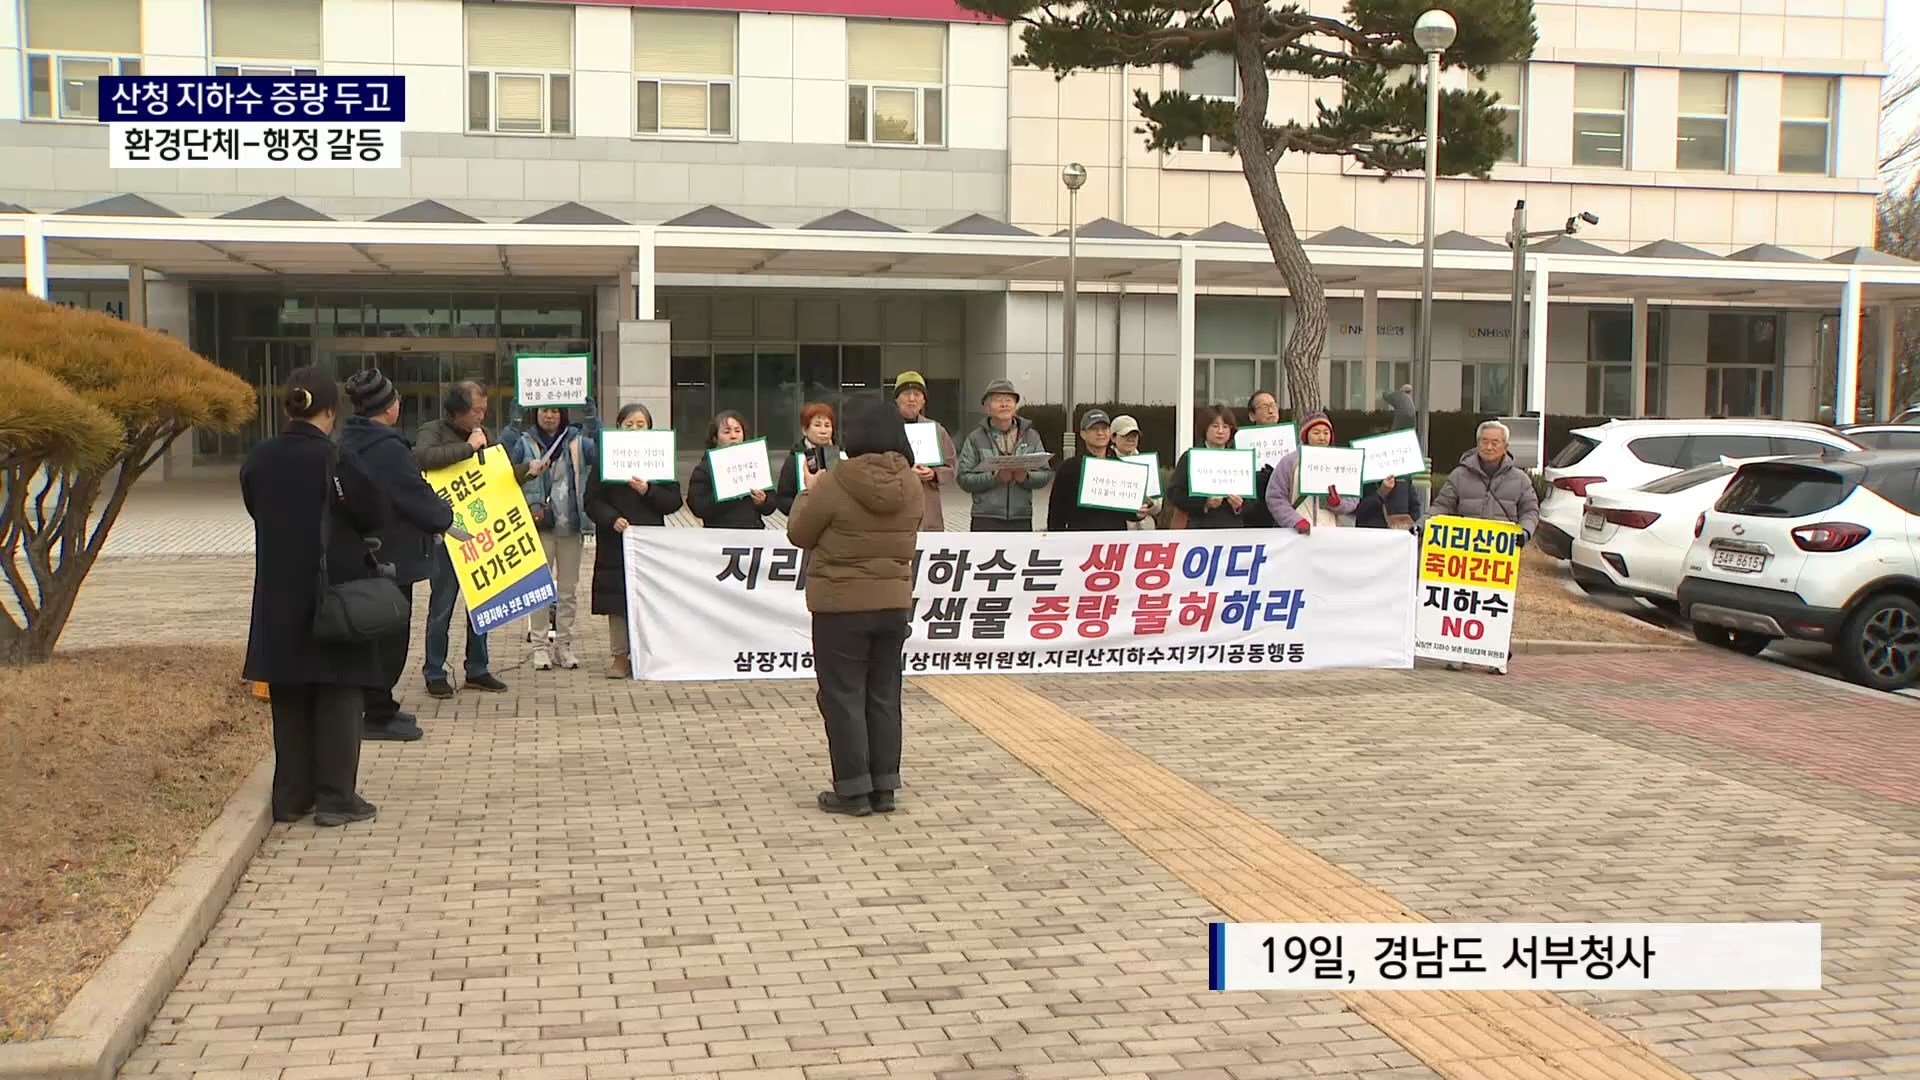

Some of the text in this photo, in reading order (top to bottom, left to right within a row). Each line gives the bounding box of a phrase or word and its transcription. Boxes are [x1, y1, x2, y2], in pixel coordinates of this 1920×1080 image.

[459, 507, 527, 564] 재앙으로
[1428, 524, 1516, 556] 지리산이
[471, 532, 538, 591] 다가온다
[1079, 542, 1266, 592] 생명이다
[1425, 553, 1513, 585] 죽어간다
[1736, 554, 1760, 568] 8615
[477, 584, 553, 628] 삼장지하수 보존 대책위원회
[1028, 595, 1119, 640] 증량
[1131, 589, 1305, 635] 불허하라
[1423, 585, 1508, 618] 지하수
[1441, 616, 1485, 640] NO
[1433, 643, 1450, 652] 지하수
